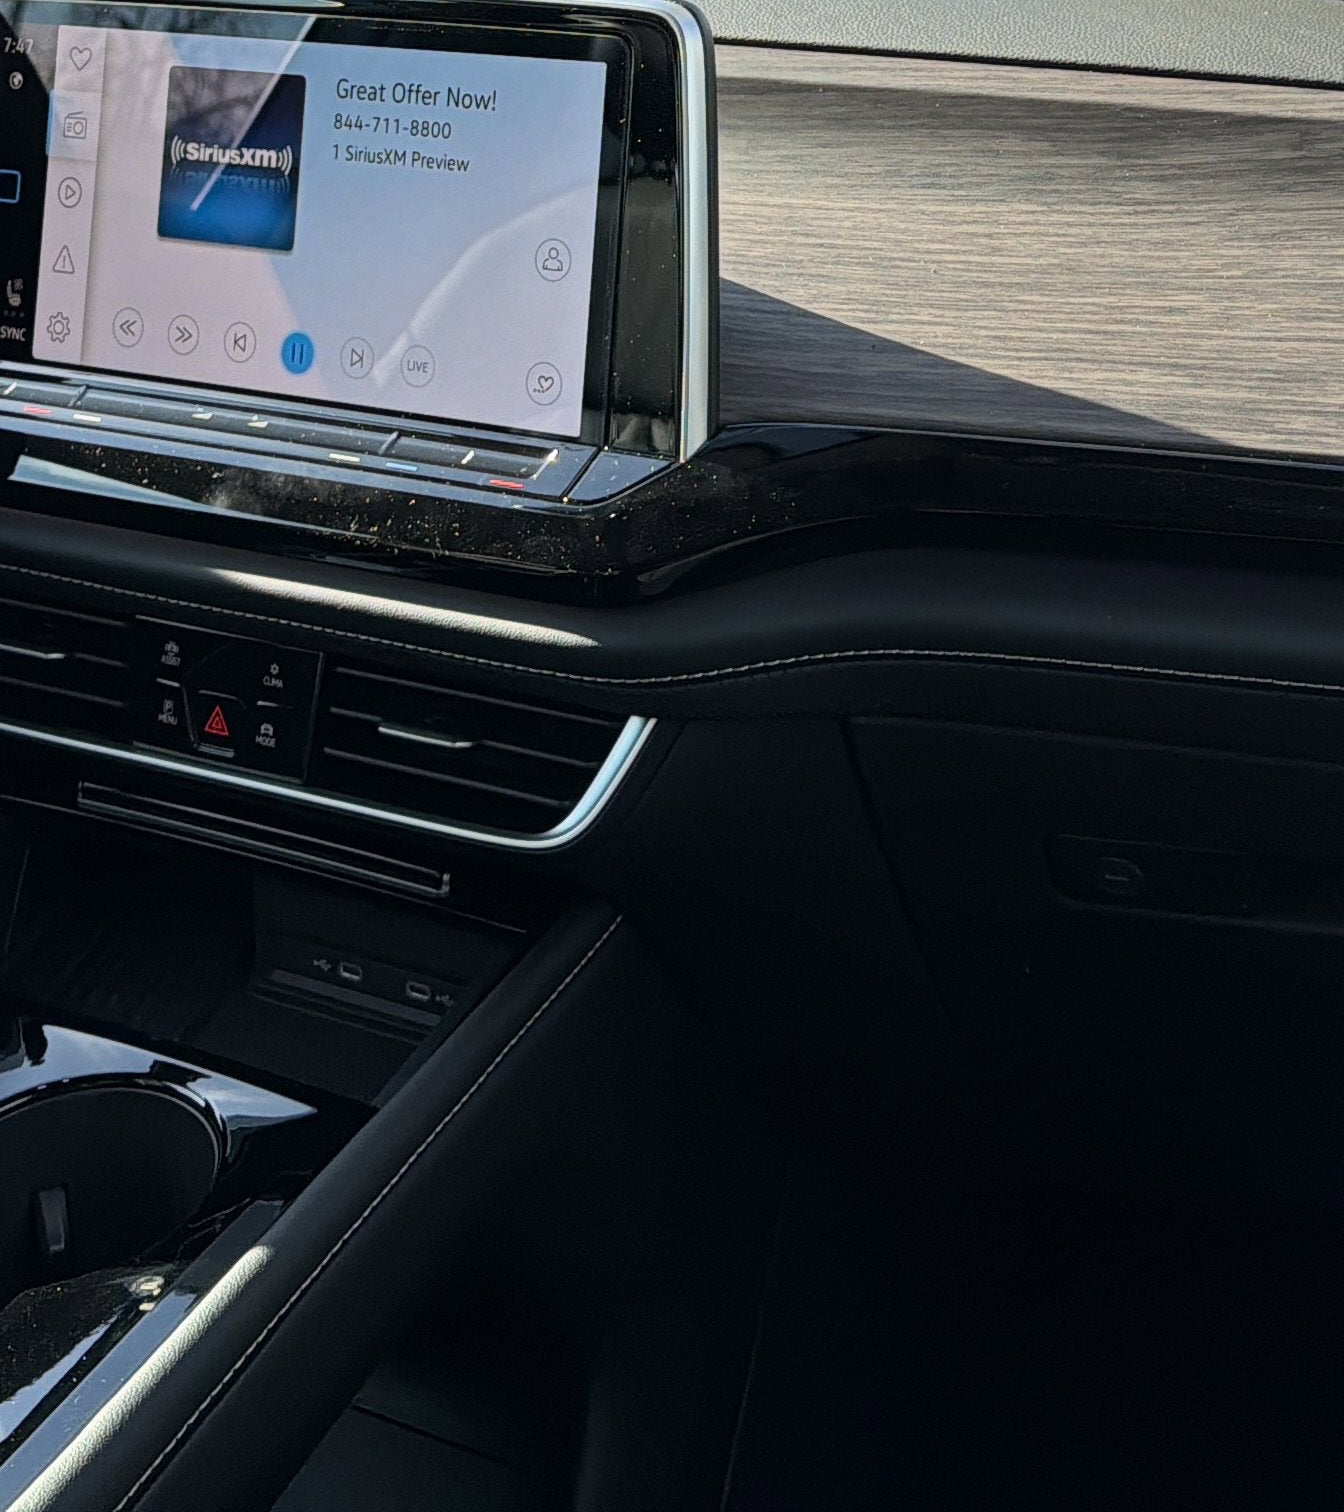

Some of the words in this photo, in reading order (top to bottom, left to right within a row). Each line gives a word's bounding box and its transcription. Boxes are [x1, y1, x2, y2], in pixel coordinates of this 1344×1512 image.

[4, 37, 34, 54] 7:47
[336, 78, 386, 102] Great
[391, 81, 441, 106] Offer
[446, 87, 497, 112] Now!
[332, 112, 452, 140] 844-711-8800
[332, 143, 340, 161] 1
[345, 144, 407, 167] SiriusXM
[410, 150, 470, 173] Preview
[0, 325, 27, 341] SYNC
[407, 359, 429, 374] LIVE
[157, 713, 178, 726] MENU
[255, 735, 277, 748] MODE
